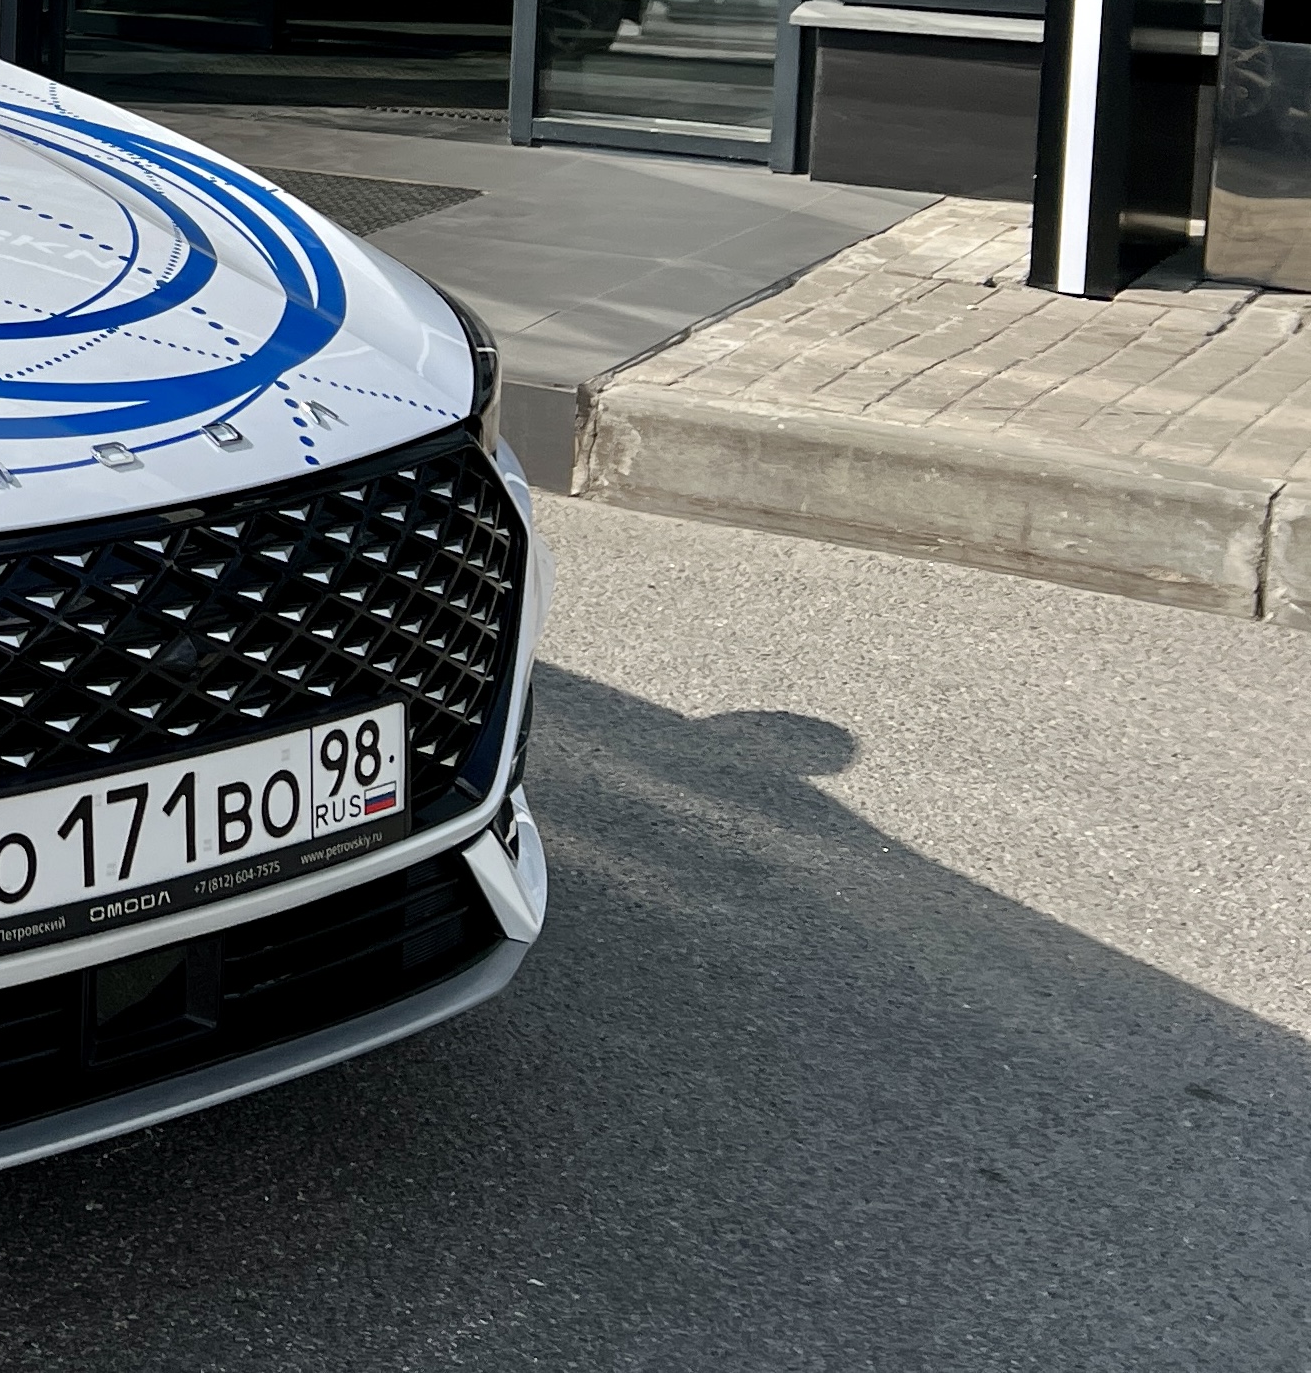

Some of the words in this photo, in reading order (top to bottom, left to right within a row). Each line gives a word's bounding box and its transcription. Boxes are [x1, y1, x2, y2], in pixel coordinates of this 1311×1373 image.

[319, 718, 382, 799] 98
[314, 793, 362, 830] RUS
[299, 830, 384, 869] www.petrovskiy.ru
[193, 882, 207, 897] +7
[208, 870, 235, 895] (812)
[234, 860, 282, 887] 604-7575
[89, 890, 172, 924] OMODA
